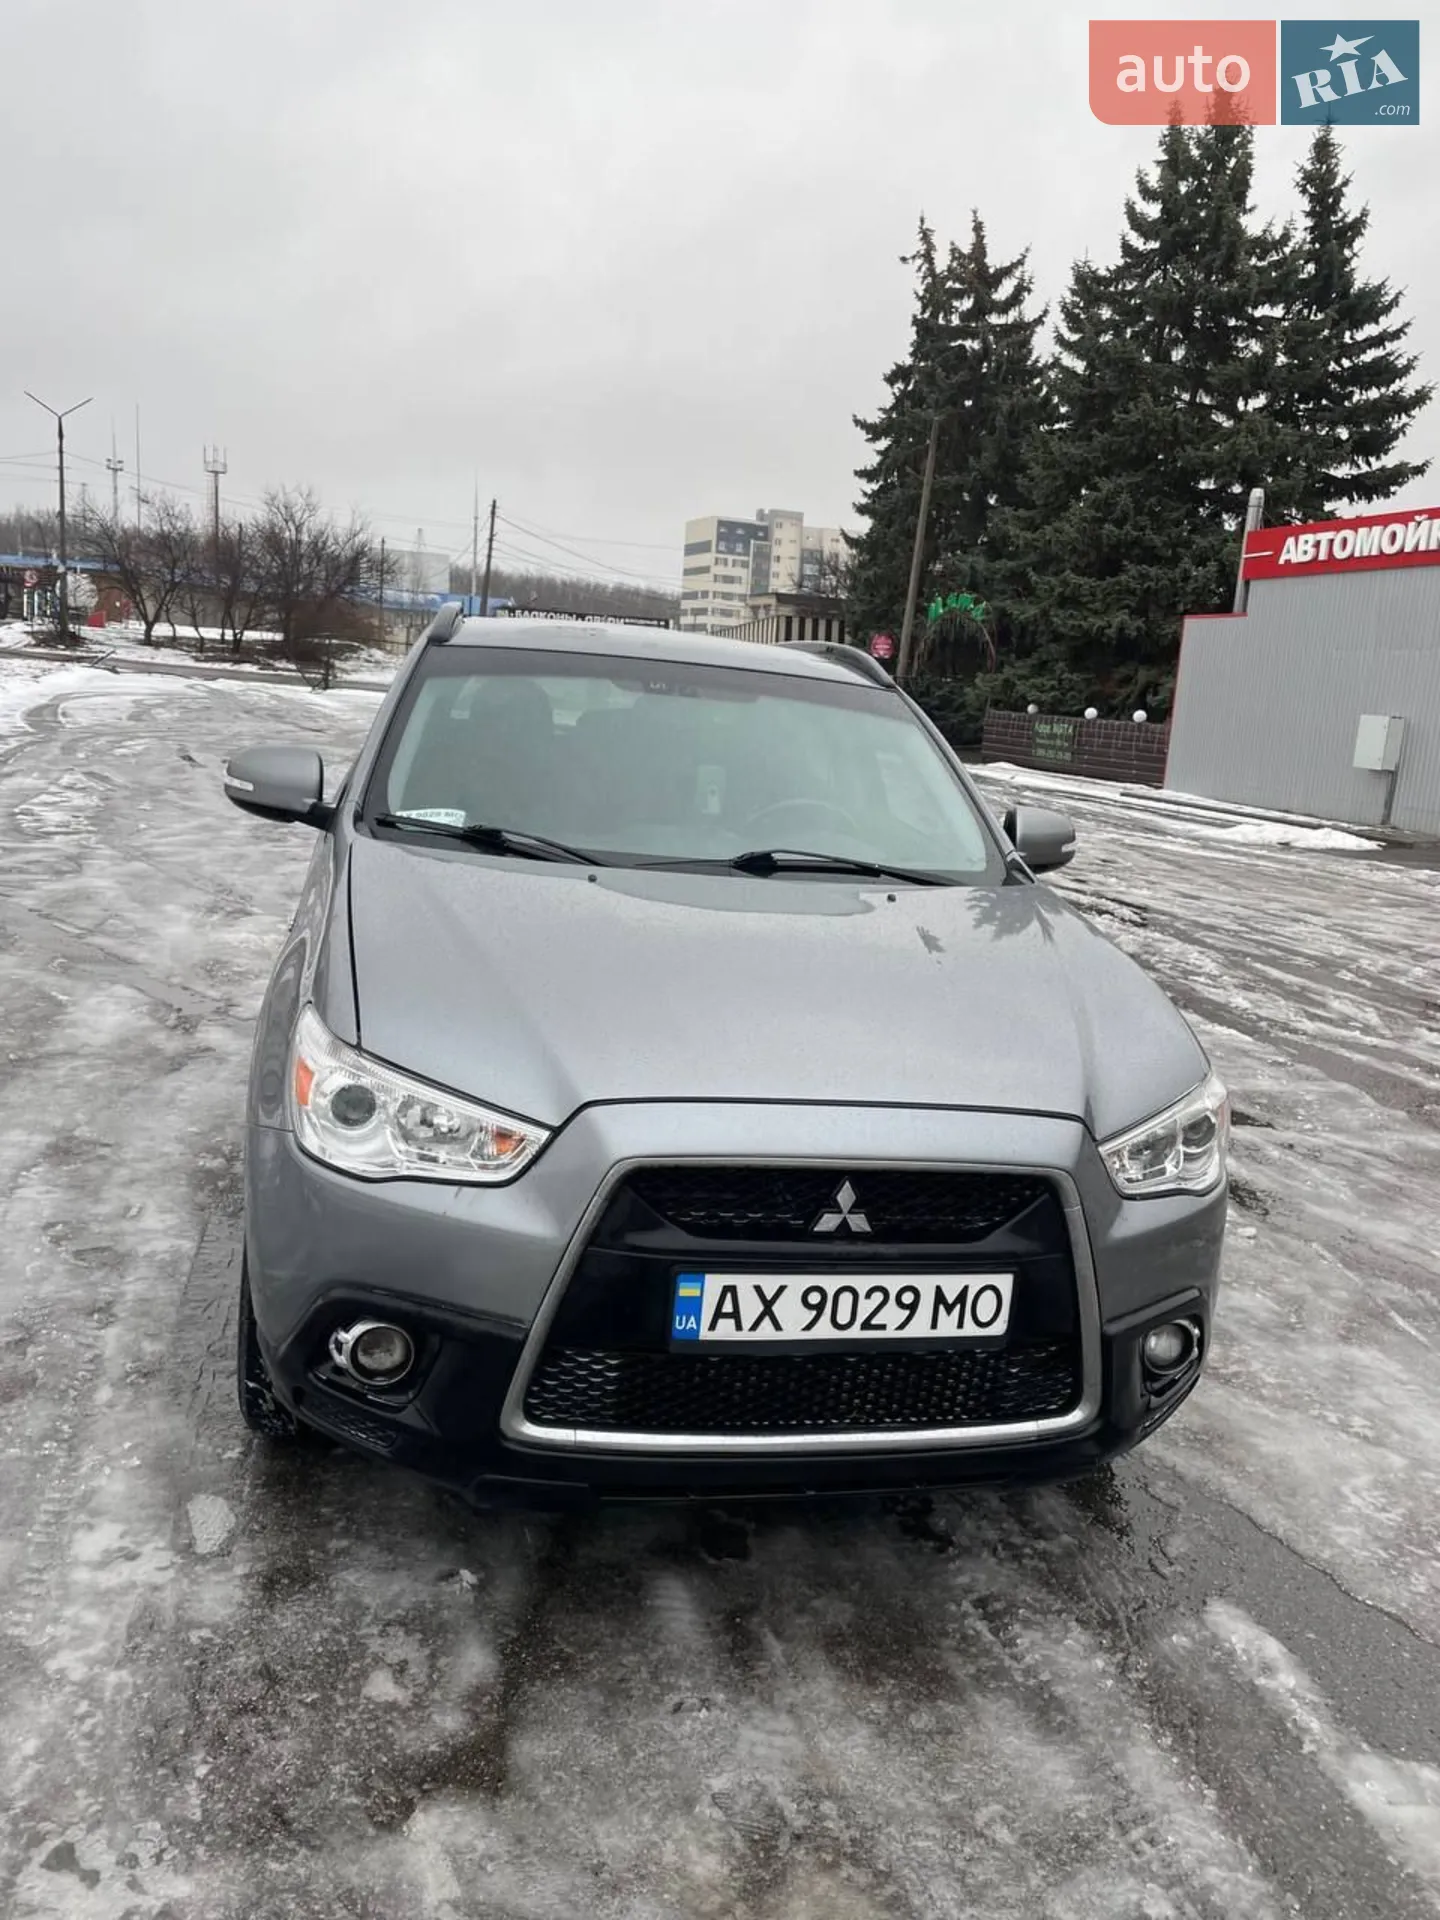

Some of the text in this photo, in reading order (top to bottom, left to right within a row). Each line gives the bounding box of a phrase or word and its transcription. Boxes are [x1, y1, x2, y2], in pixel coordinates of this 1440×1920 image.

[675, 1315, 697, 1330] UA
[707, 1284, 1001, 1332] AX 9029 MO
